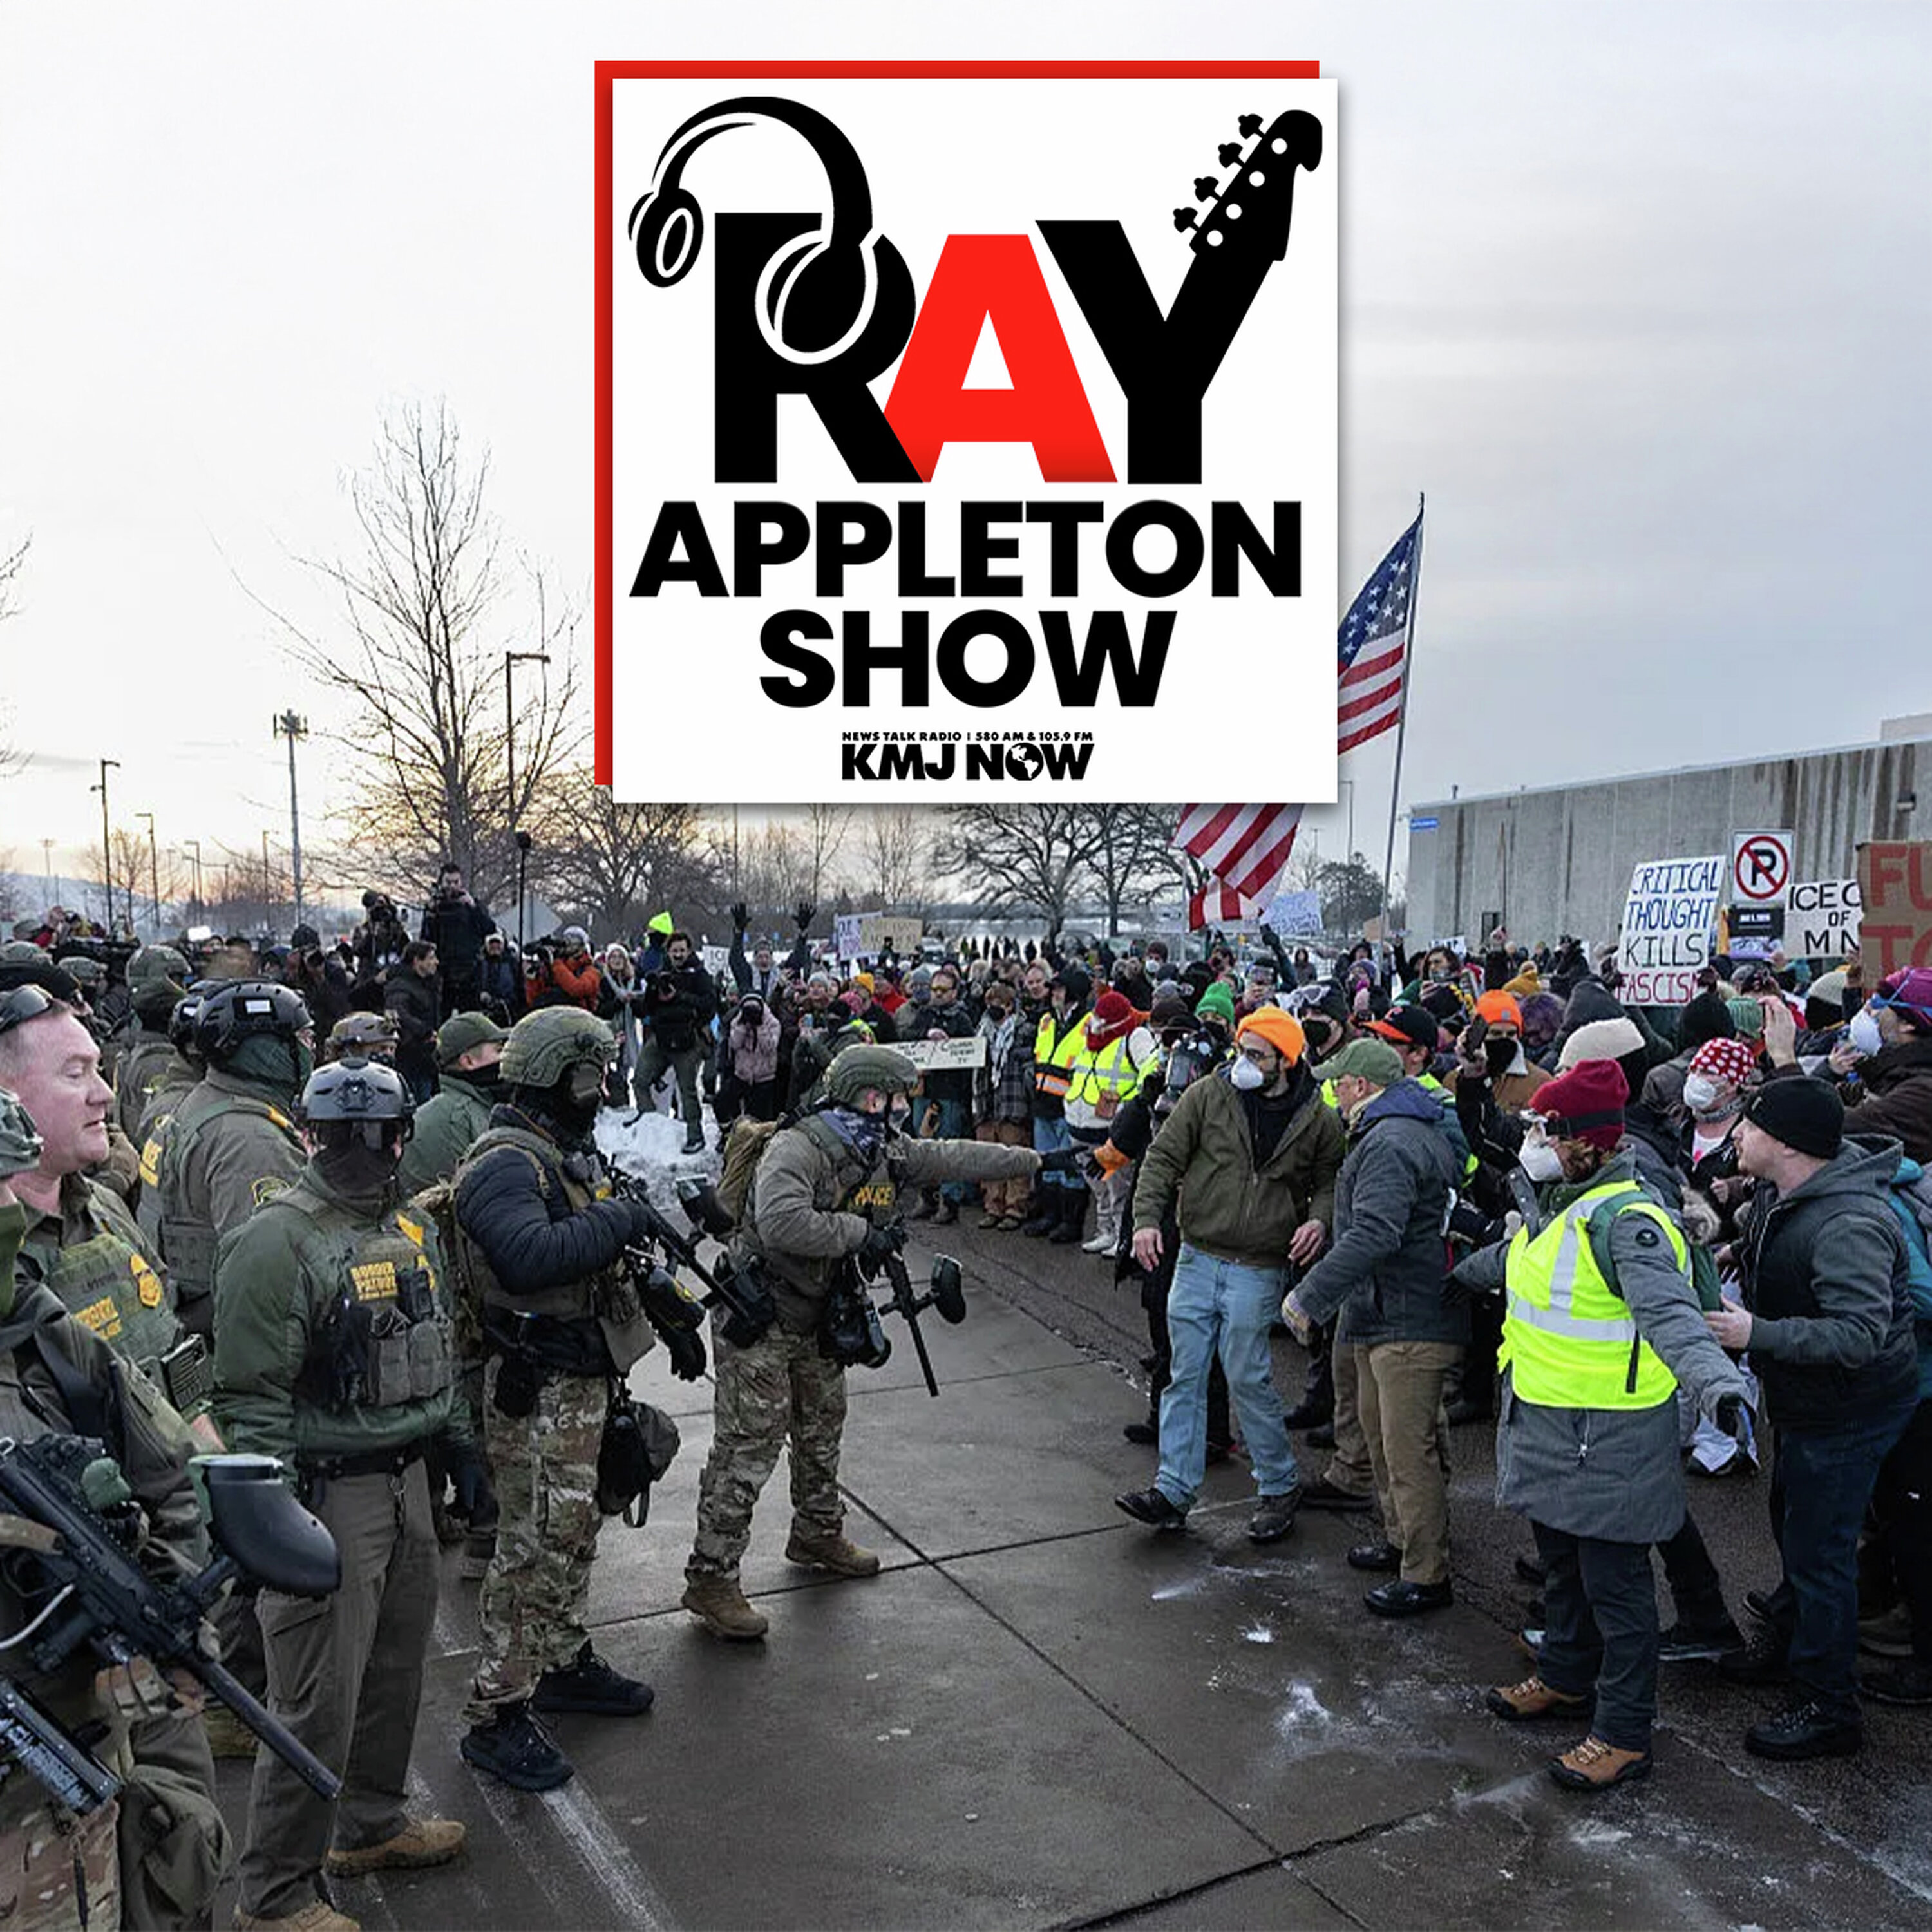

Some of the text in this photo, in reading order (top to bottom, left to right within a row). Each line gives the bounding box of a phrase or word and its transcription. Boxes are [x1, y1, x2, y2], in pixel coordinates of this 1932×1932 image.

[1632, 861, 1718, 895] CRITICAL
[1789, 883, 1838, 911] ICE
[1627, 898, 1715, 931] THOUGHT
[1828, 910, 1852, 927] OF
[1624, 934, 1704, 967] KILLS
